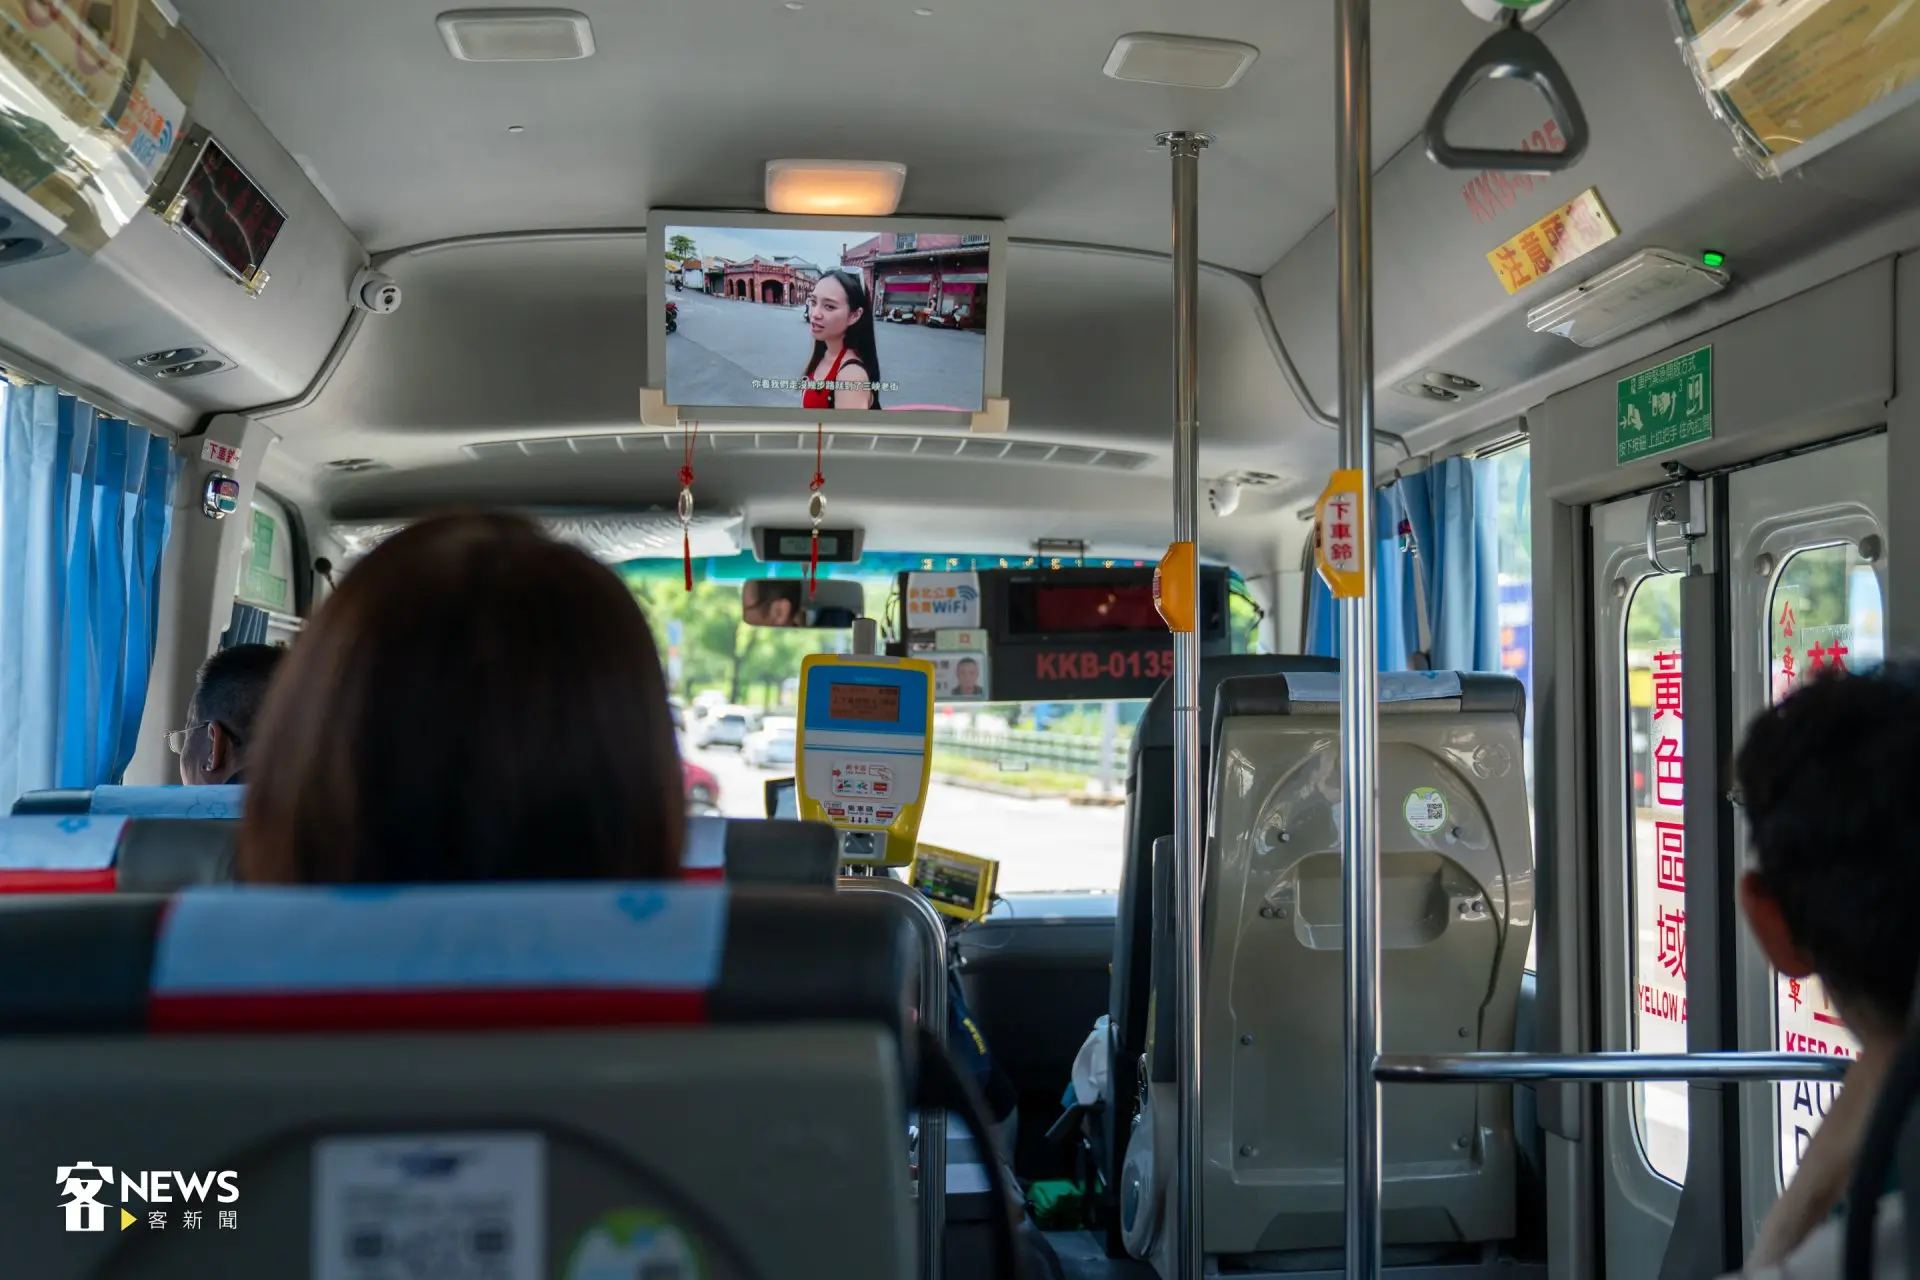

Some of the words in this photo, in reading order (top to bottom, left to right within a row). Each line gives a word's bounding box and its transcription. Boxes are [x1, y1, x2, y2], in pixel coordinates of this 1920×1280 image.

[1328, 502, 1352, 561] 下車鈴
[1036, 651, 1174, 679] KKB-0135
[1652, 650, 1686, 982] 黃色區域
[1637, 983, 1678, 1022] YELLOW
